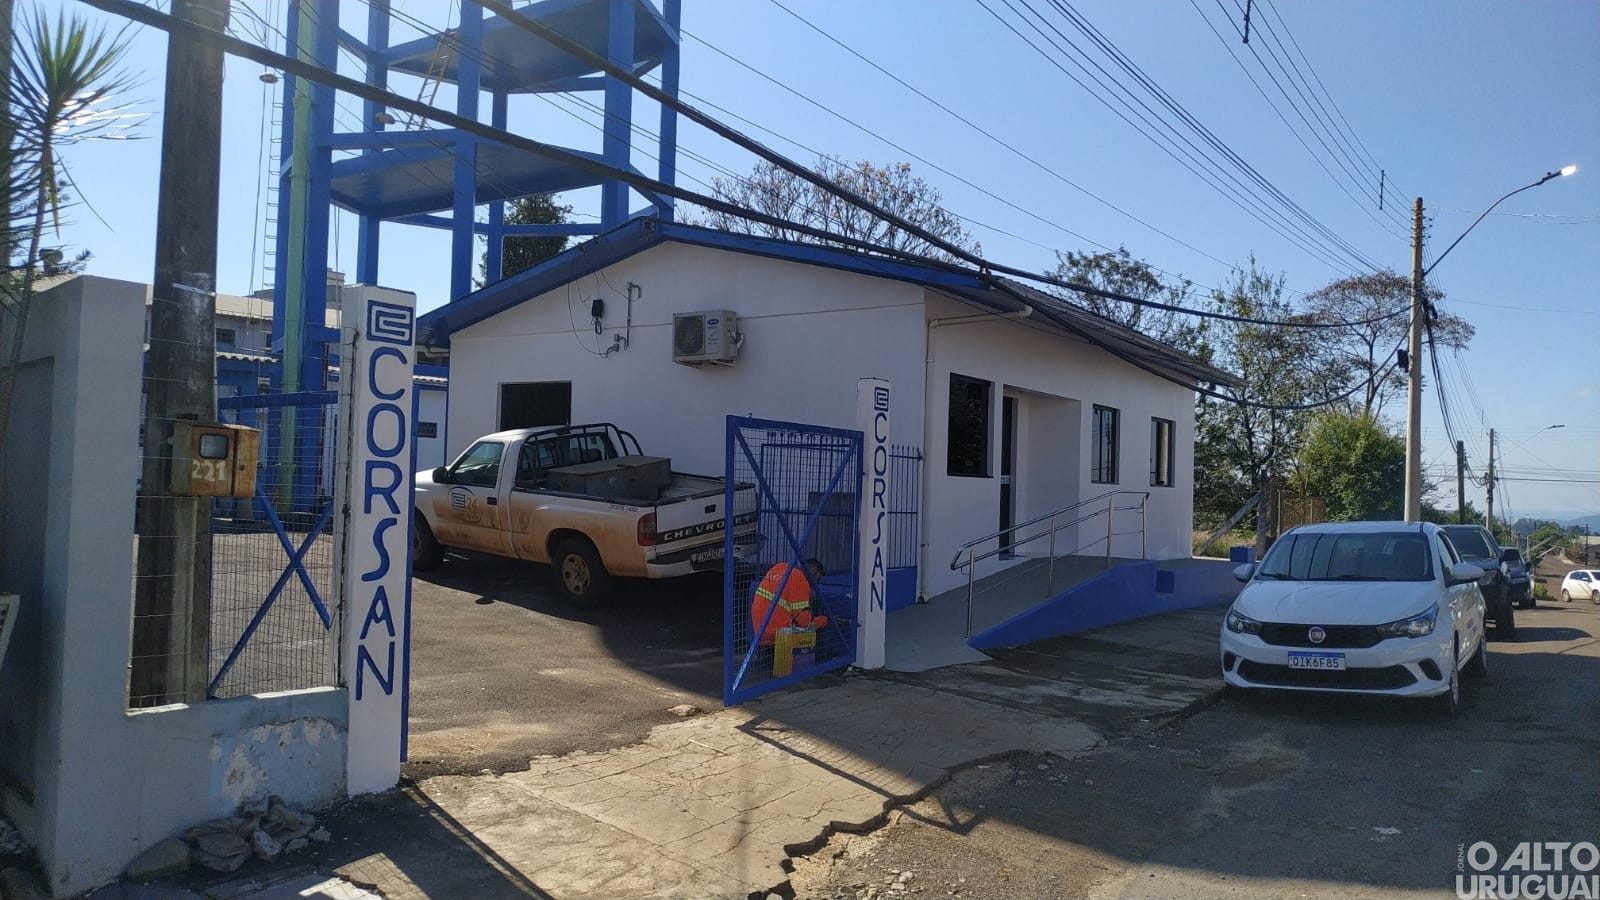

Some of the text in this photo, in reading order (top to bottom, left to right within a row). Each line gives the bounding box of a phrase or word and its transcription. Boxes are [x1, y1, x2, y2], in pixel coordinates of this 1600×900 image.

[192, 459, 226, 482] 221
[355, 346, 408, 701] CORSAN
[870, 412, 887, 613] CORSAN
[664, 515, 751, 541] CHEVROET
